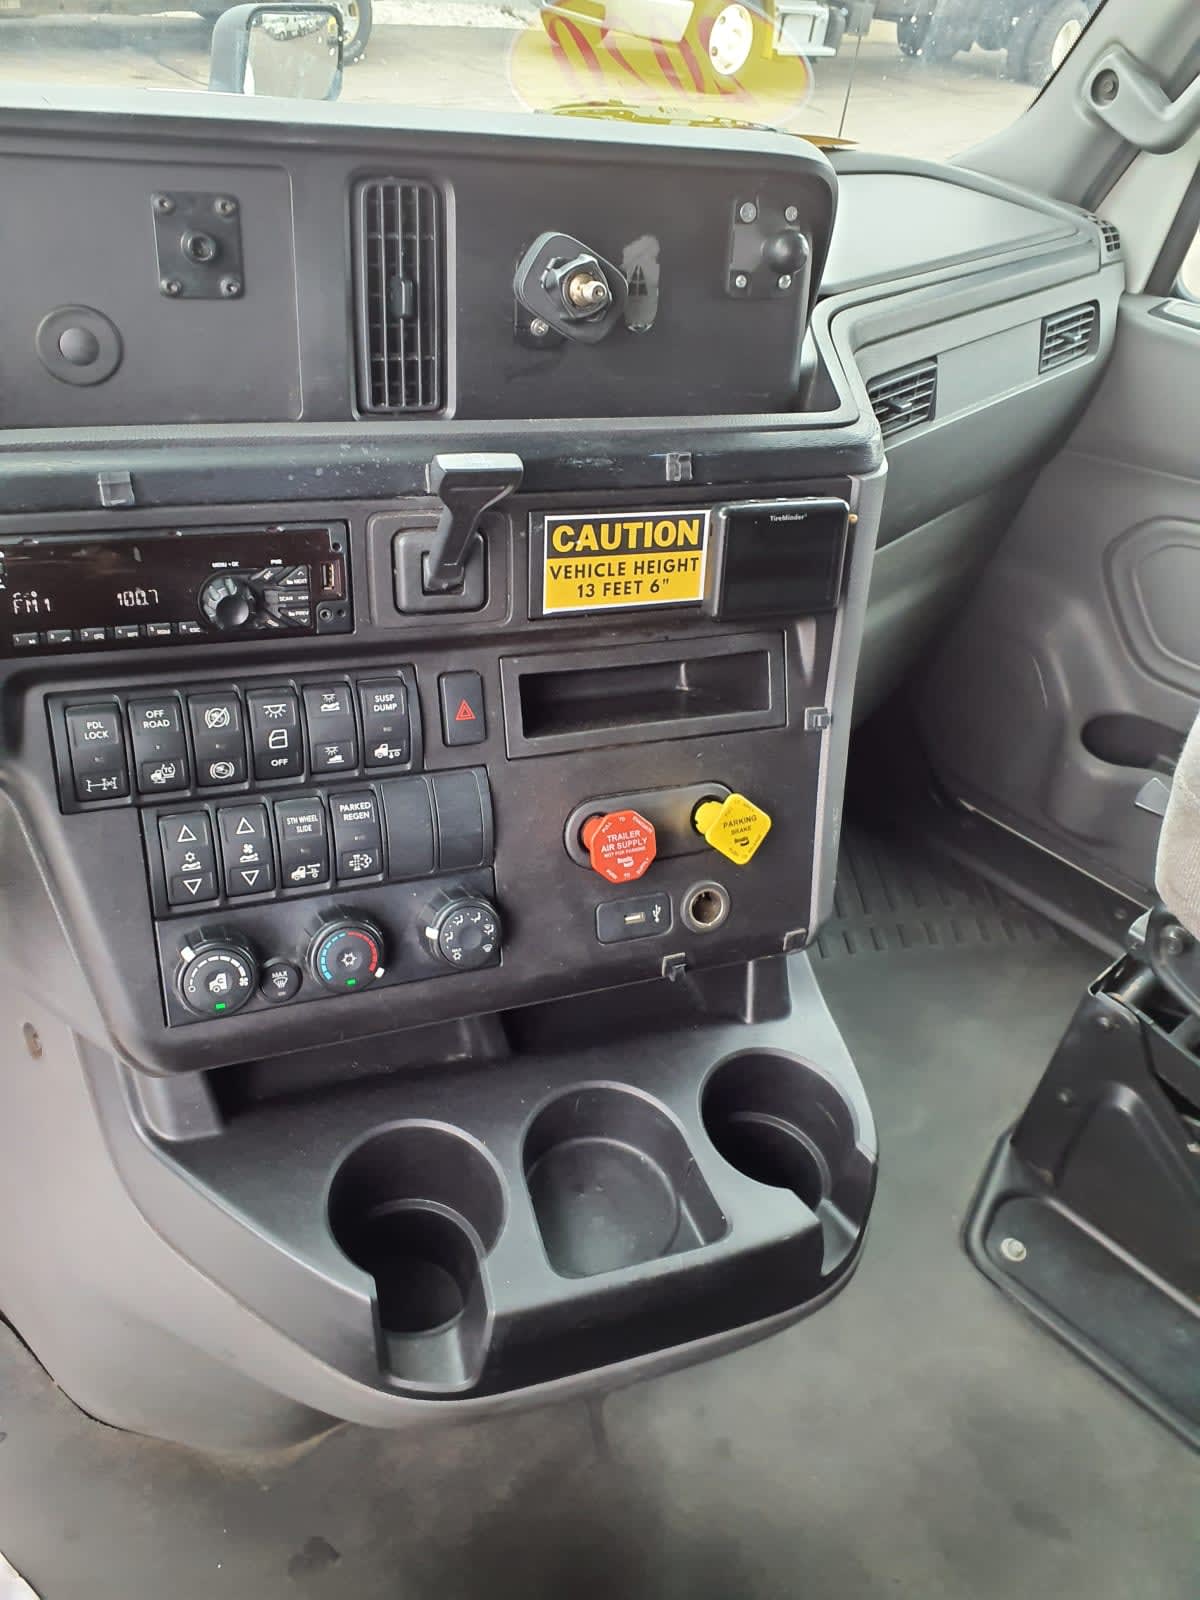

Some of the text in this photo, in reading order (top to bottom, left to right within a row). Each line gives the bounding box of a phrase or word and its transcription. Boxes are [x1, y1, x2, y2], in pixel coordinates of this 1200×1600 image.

[552, 519, 700, 553] CAUTION
[550, 557, 699, 580] VEHICLE HEIGHT
[577, 578, 669, 598] 13 FEET 6"
[374, 693, 395, 703] SUSP
[373, 703, 398, 712] DUMP
[145, 709, 165, 719] OFF
[86, 721, 104, 730] PDL
[143, 719, 170, 729] ROAD
[84, 730, 109, 740] LOCK
[270, 758, 289, 767] OFF
[340, 801, 371, 813] PARKED
[299, 814, 319, 823] WHEEL
[343, 811, 370, 821] REGEN
[723, 814, 757, 829] PARKING
[296, 824, 313, 833] SLIDE
[607, 829, 641, 843] TRAILER
[601, 836, 648, 854] AIR SUPPLY
[271, 970, 288, 979] MAX
